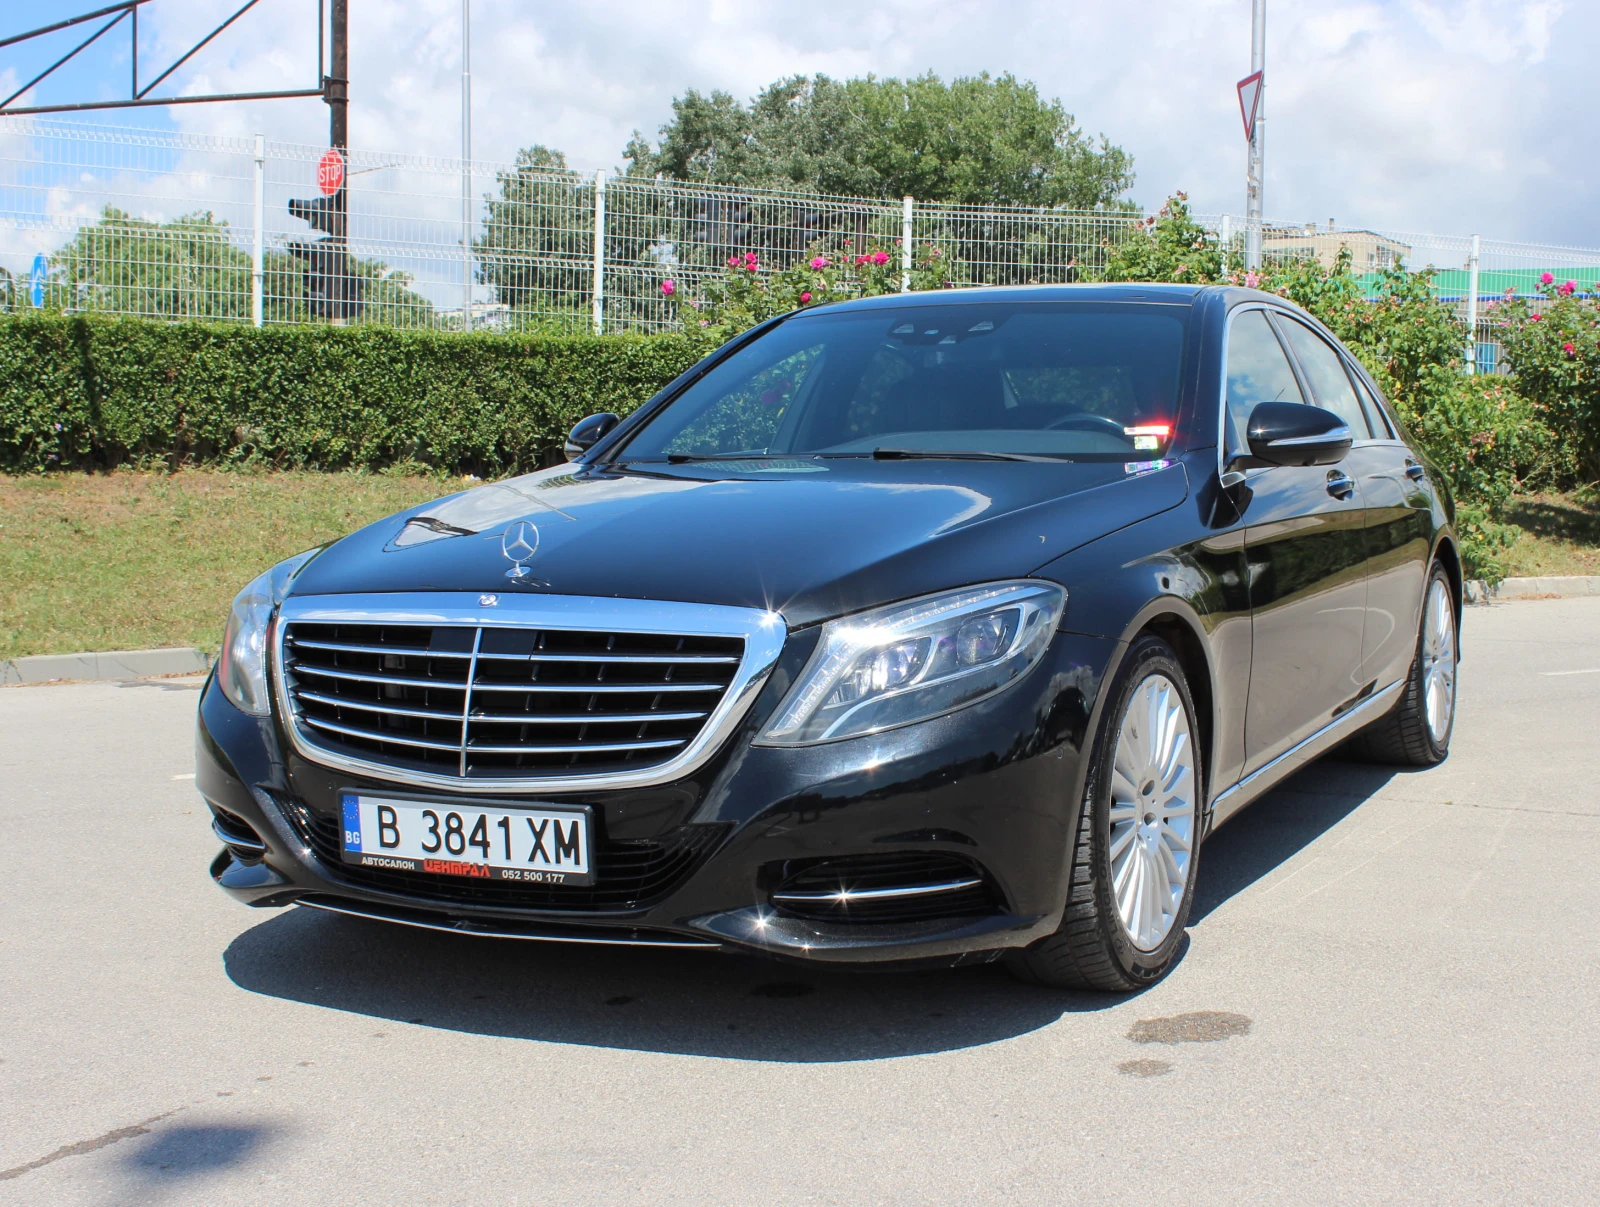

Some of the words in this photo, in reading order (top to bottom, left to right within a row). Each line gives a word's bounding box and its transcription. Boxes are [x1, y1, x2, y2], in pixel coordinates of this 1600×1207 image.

[320, 164, 341, 183] STOP
[345, 831, 361, 845] BG
[377, 805, 401, 849] B
[421, 809, 512, 861] 3841
[526, 817, 581, 866] XM
[361, 857, 415, 870] АВТОСАЛОН
[502, 869, 521, 880] 052
[523, 872, 543, 882] 500
[545, 874, 565, 883] 177
